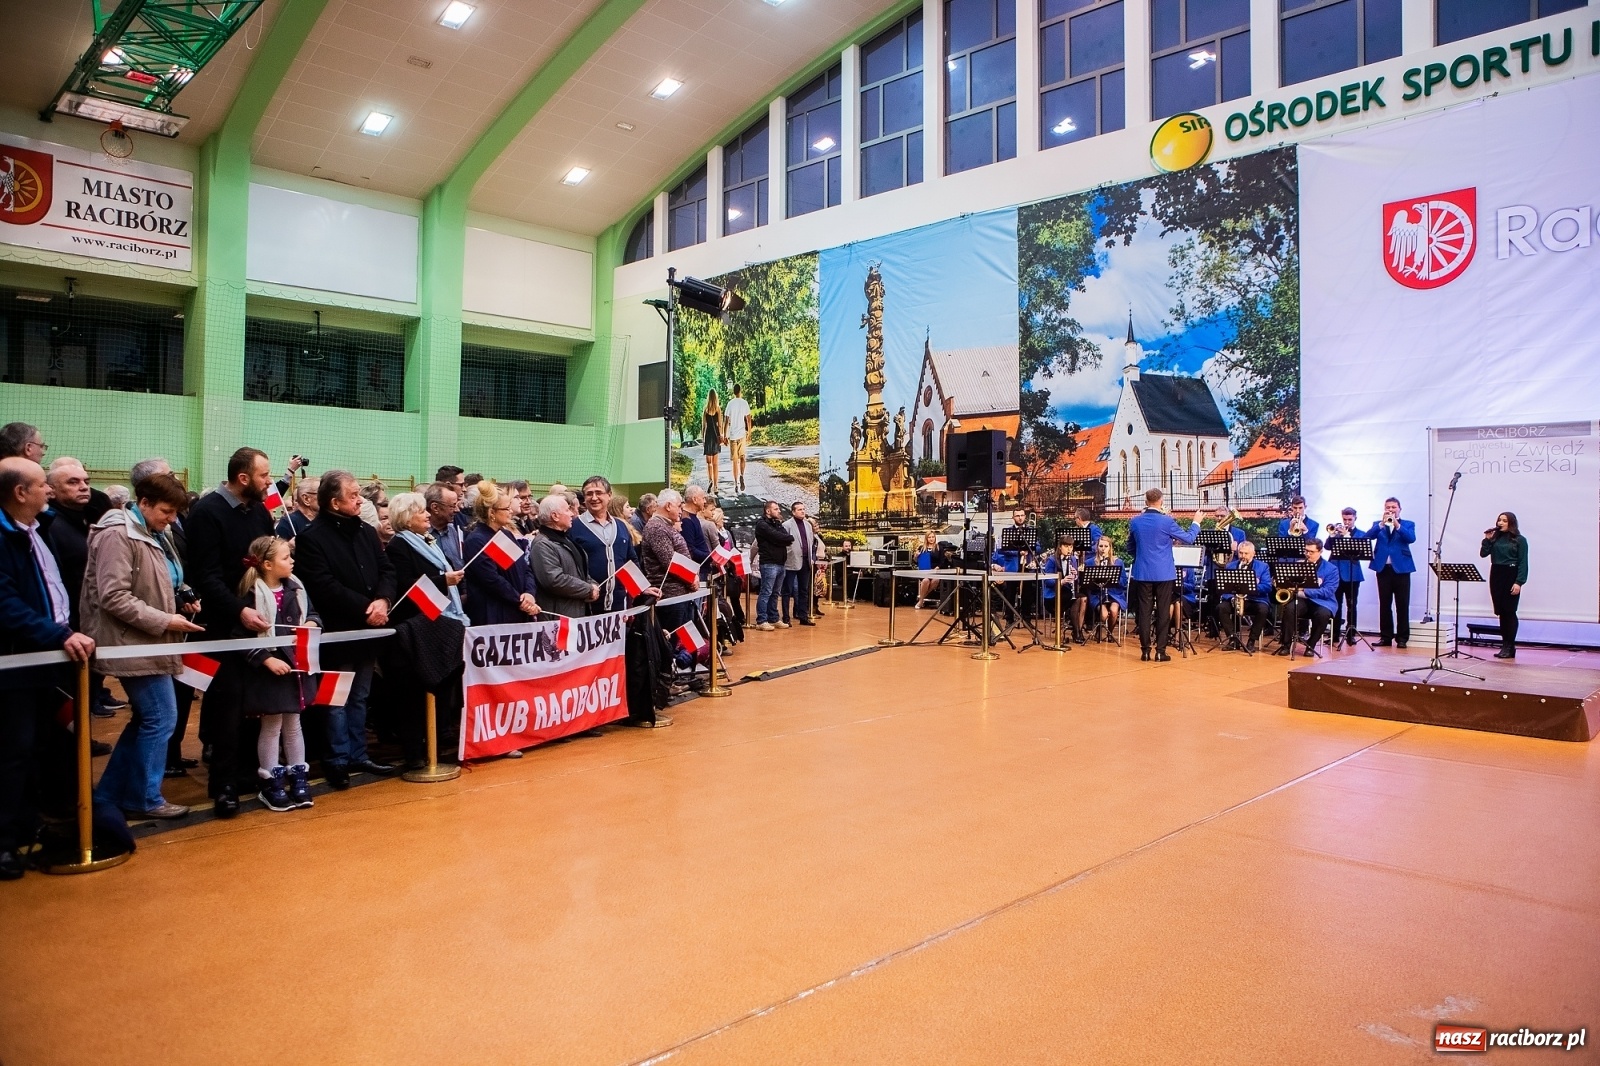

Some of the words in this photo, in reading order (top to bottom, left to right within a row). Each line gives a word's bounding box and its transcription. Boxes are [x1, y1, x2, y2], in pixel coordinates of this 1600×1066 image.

[1224, 75, 1386, 142] OŚRODEK
[1402, 27, 1572, 101] SPORTU
[82, 177, 174, 211] MIASTO
[65, 200, 188, 238] RACIBÓRZ
[1496, 204, 1600, 260] Ra
[71, 235, 178, 259] www.raciborz.pl
[1468, 440, 1514, 450] Inwestuj
[1477, 424, 1547, 439] RACIBÓRZ
[1444, 447, 1485, 460] Pracuj
[1515, 439, 1585, 457] Zwiedź
[1455, 454, 1577, 476] Zamieszkaj
[471, 630, 546, 668] GAZETA
[564, 614, 622, 657] OLSKA
[473, 699, 530, 743] KLUB
[533, 673, 622, 731] RACIBÓRZ
